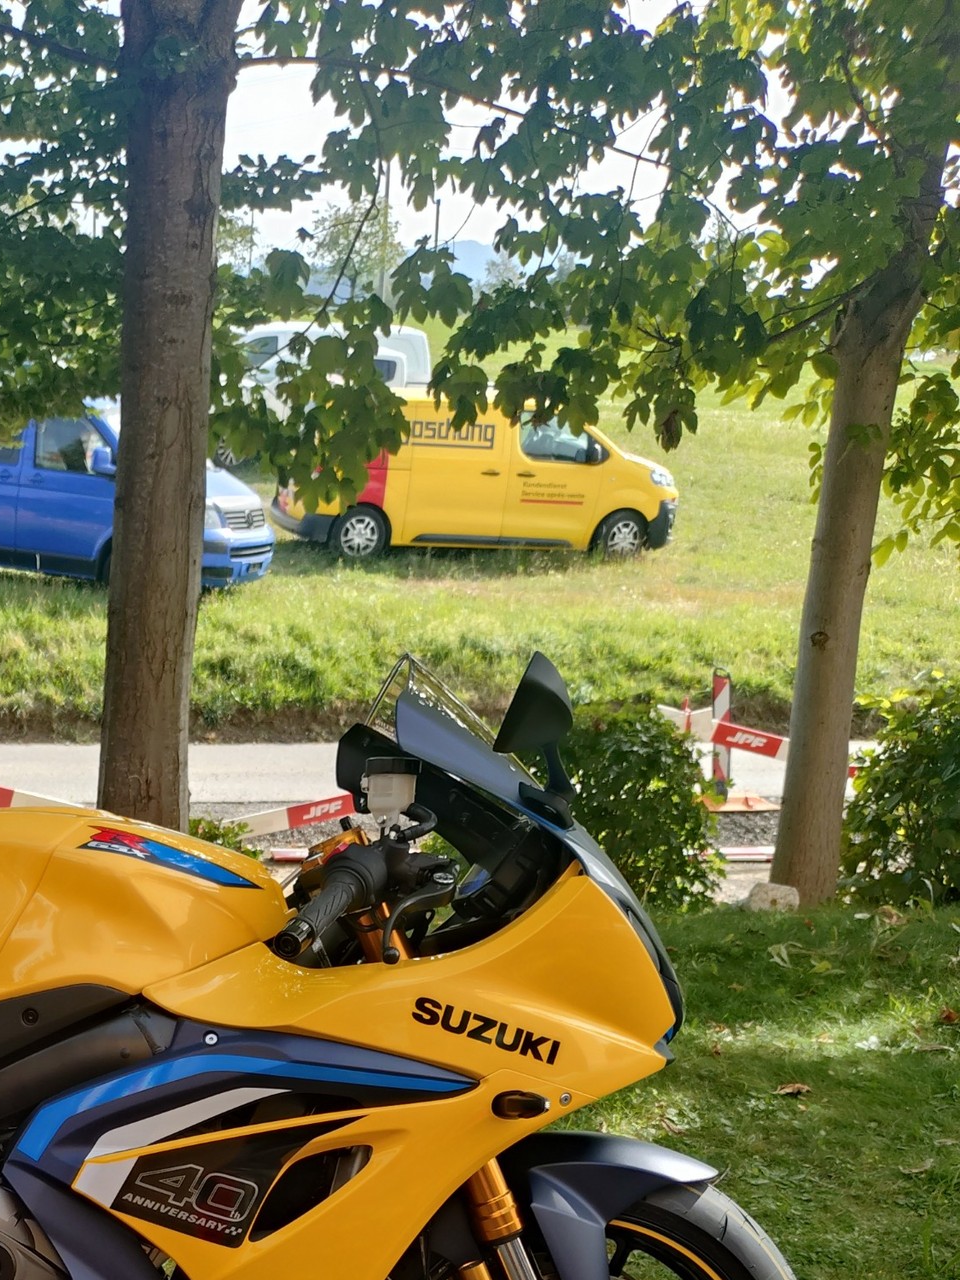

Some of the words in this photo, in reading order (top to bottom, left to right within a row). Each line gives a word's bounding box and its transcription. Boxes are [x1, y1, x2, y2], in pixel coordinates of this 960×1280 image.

[401, 417, 495, 450] oschung
[726, 731, 769, 748] JPF
[302, 799, 343, 820] JPF
[411, 996, 561, 1066] SUZUKI
[122, 1192, 227, 1232] ANNIVERSARY
